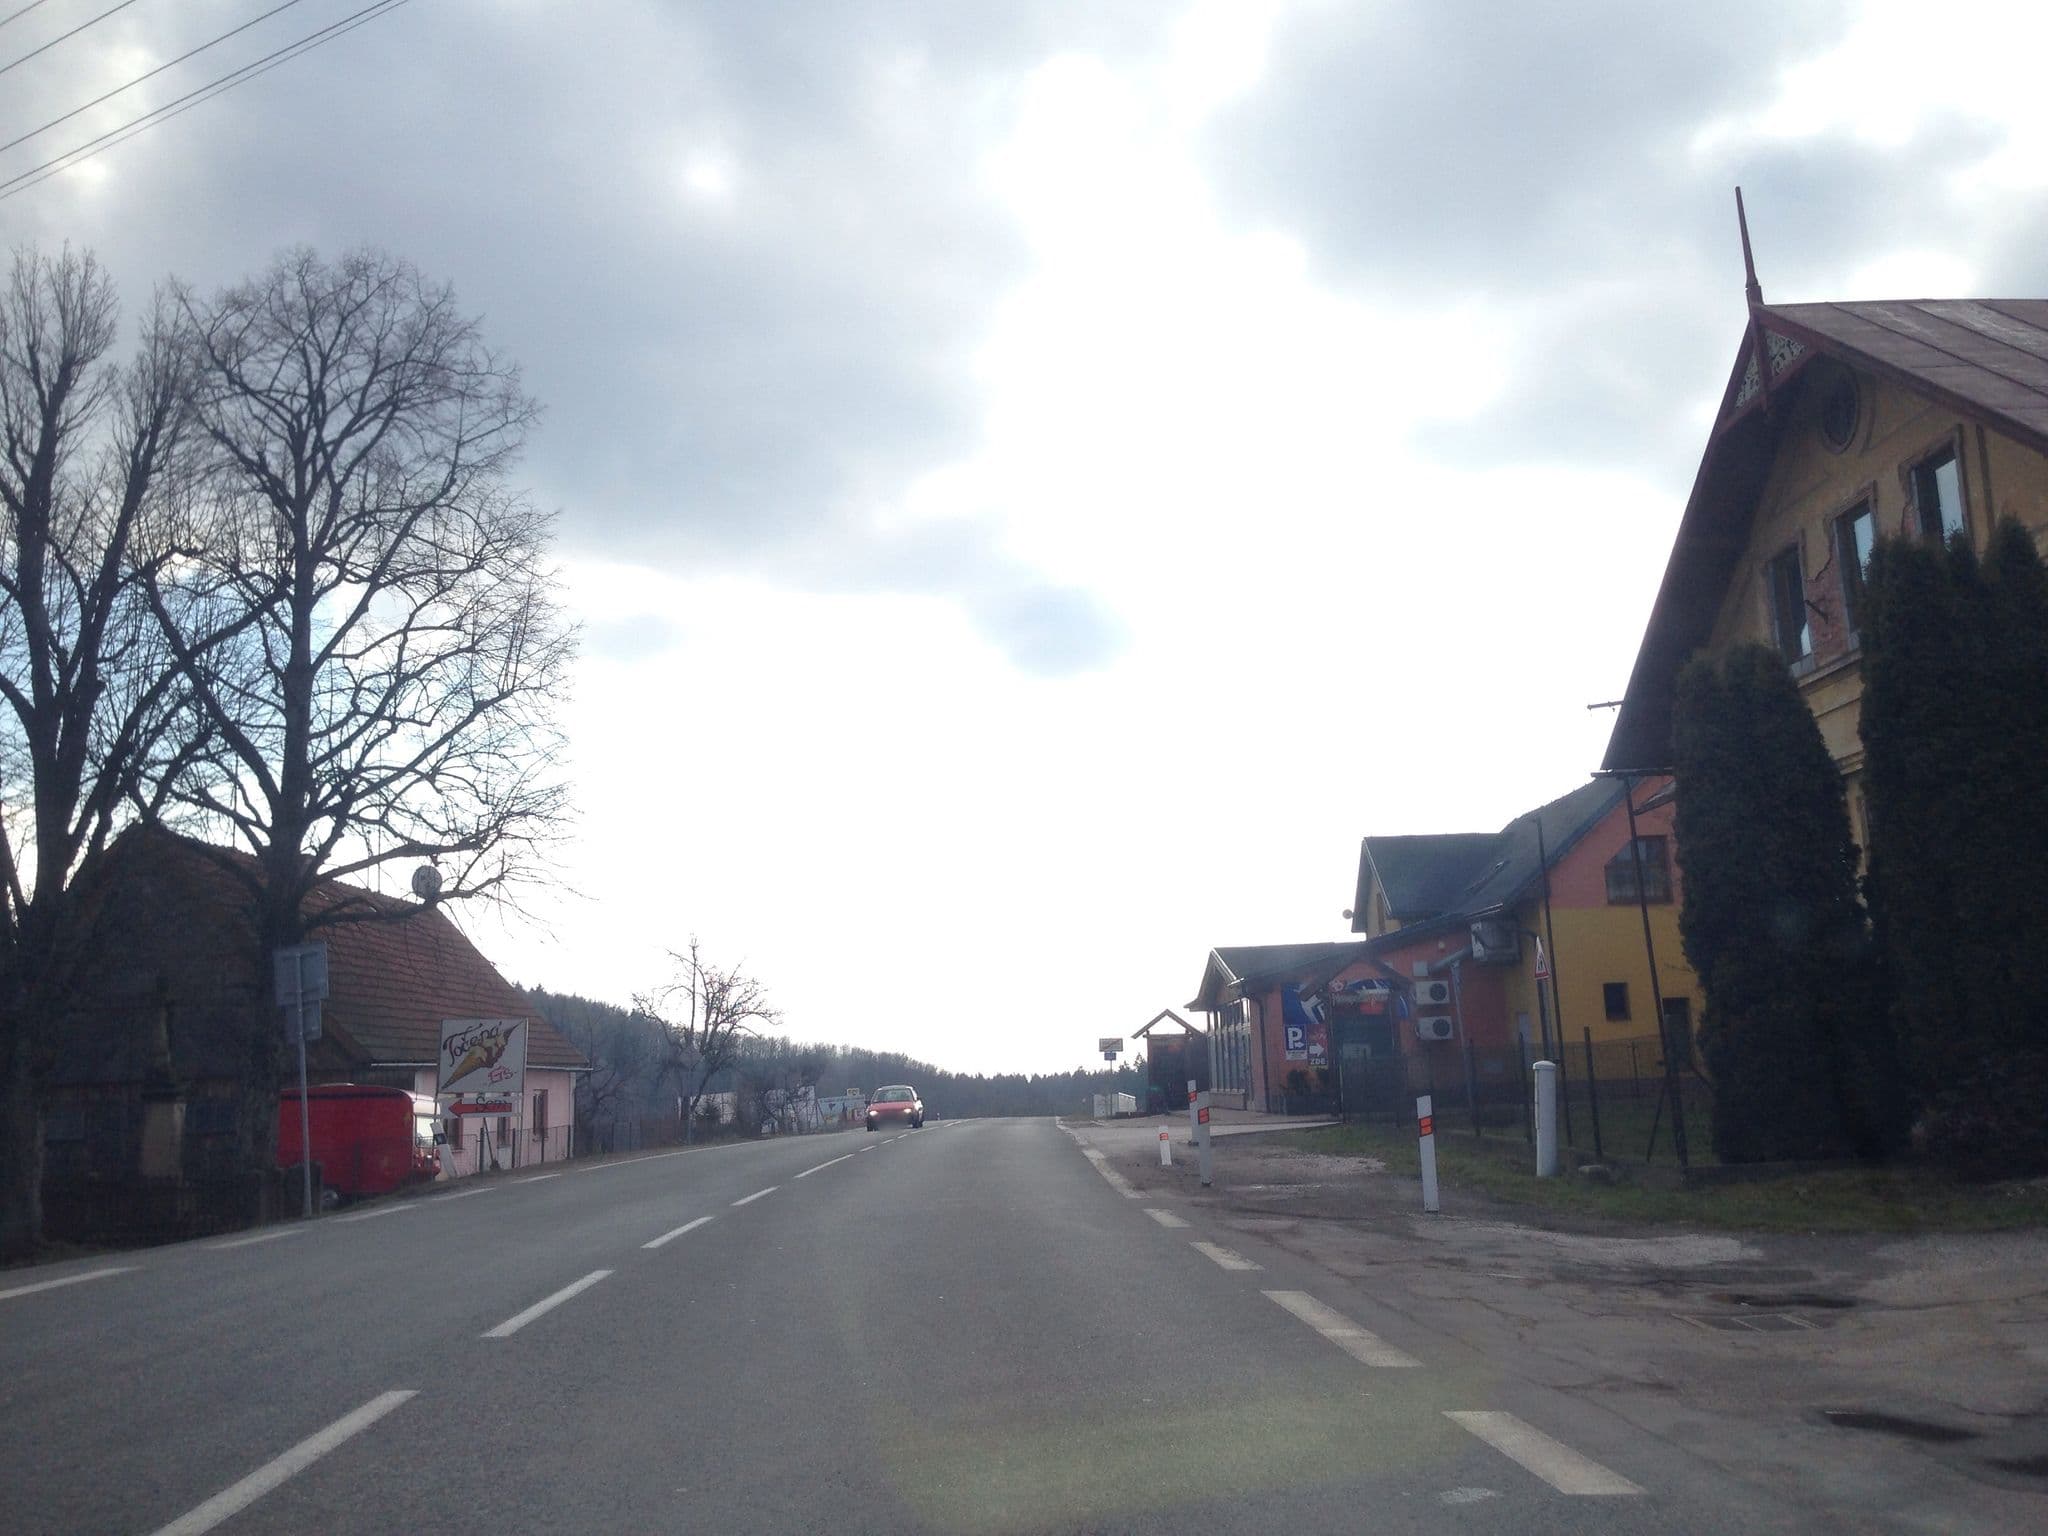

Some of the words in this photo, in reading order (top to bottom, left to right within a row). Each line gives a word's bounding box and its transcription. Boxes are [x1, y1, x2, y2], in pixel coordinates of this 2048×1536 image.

[442, 1020, 502, 1067] Točená
[1287, 1027, 1303, 1049] P
[1310, 1057, 1326, 1065] ZDE
